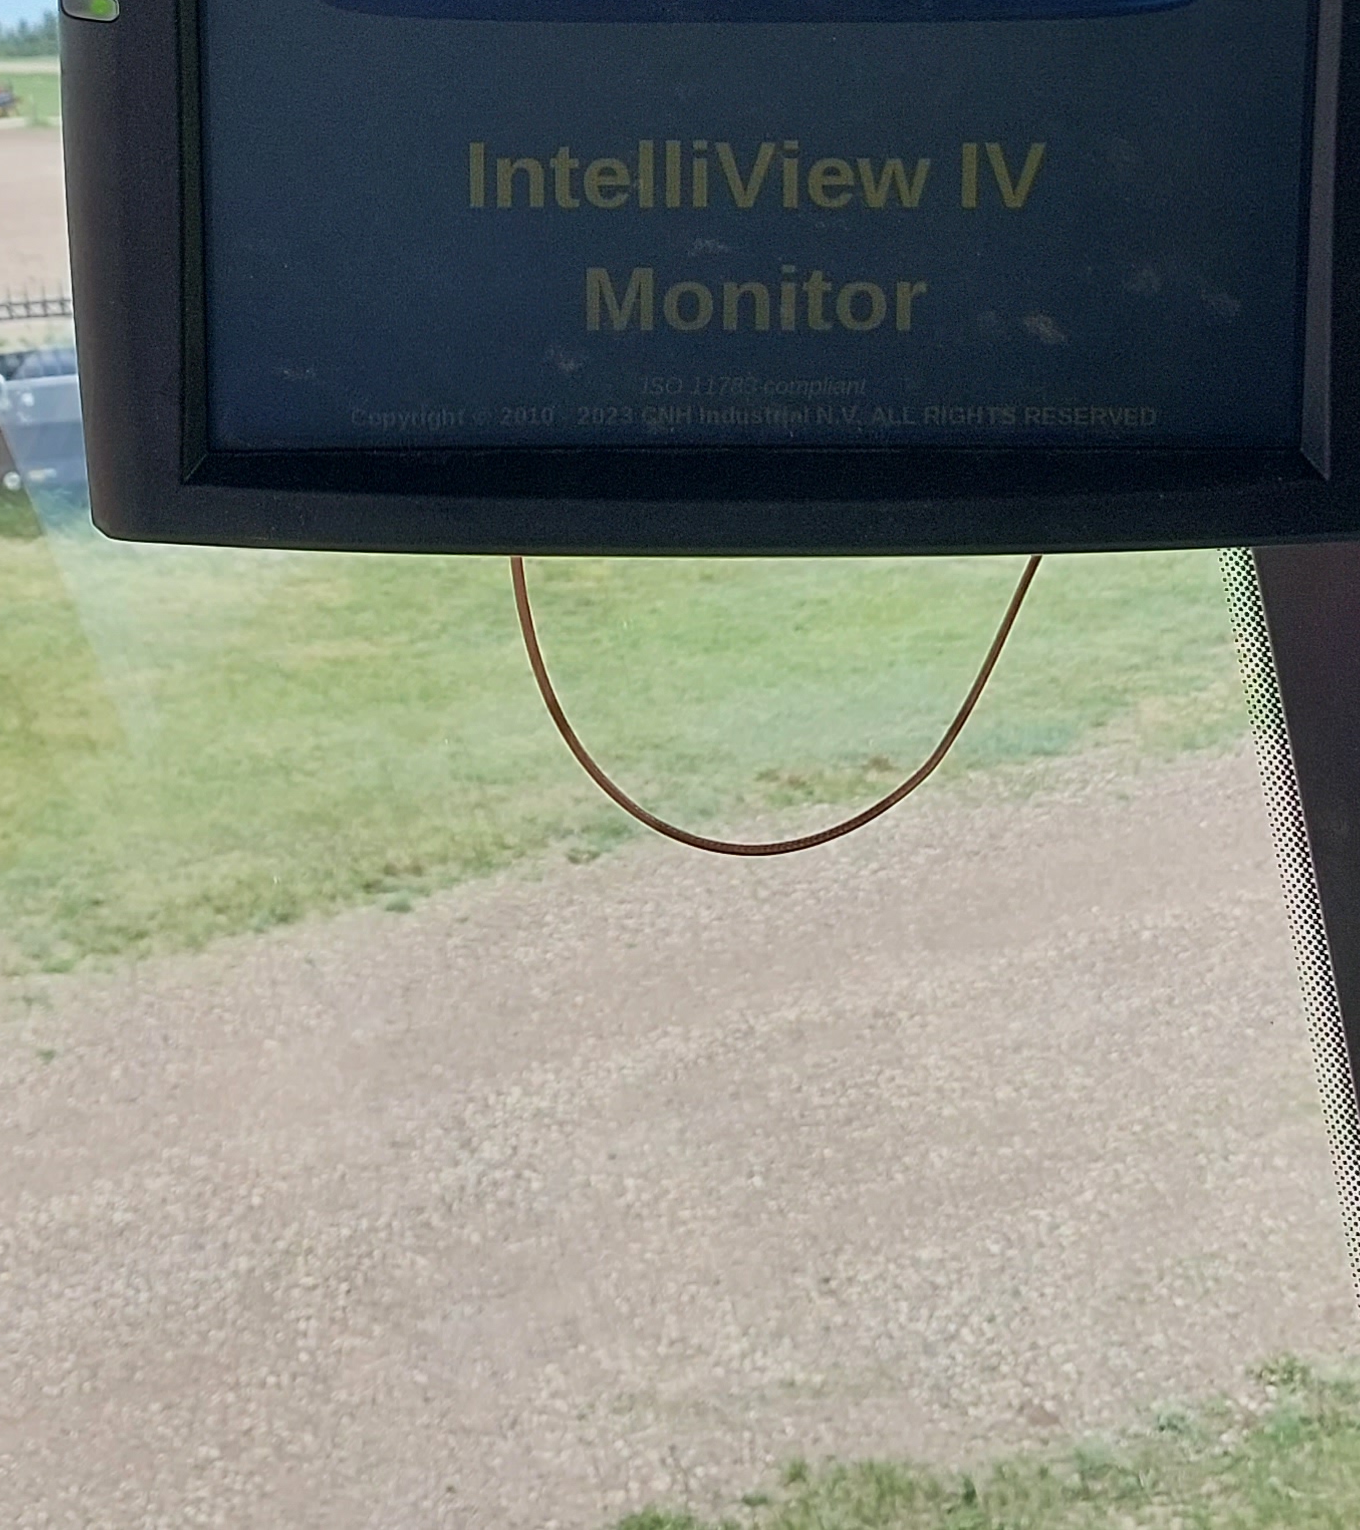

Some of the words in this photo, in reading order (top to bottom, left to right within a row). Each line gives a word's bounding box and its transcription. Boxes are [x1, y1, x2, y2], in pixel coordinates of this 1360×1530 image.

[469, 140, 930, 209] IntelliView
[960, 141, 1046, 209] IV
[585, 265, 927, 331] Monitor
[640, 376, 684, 396] ISO
[763, 377, 867, 400] compliant
[350, 406, 465, 431] Copyright
[500, 406, 555, 426] 2010
[577, 406, 634, 426] 2023
[641, 406, 692, 426] CNH
[870, 406, 916, 426] ALL
[923, 406, 1016, 426] RIGHTS
[1024, 406, 1157, 426] RESERVED
